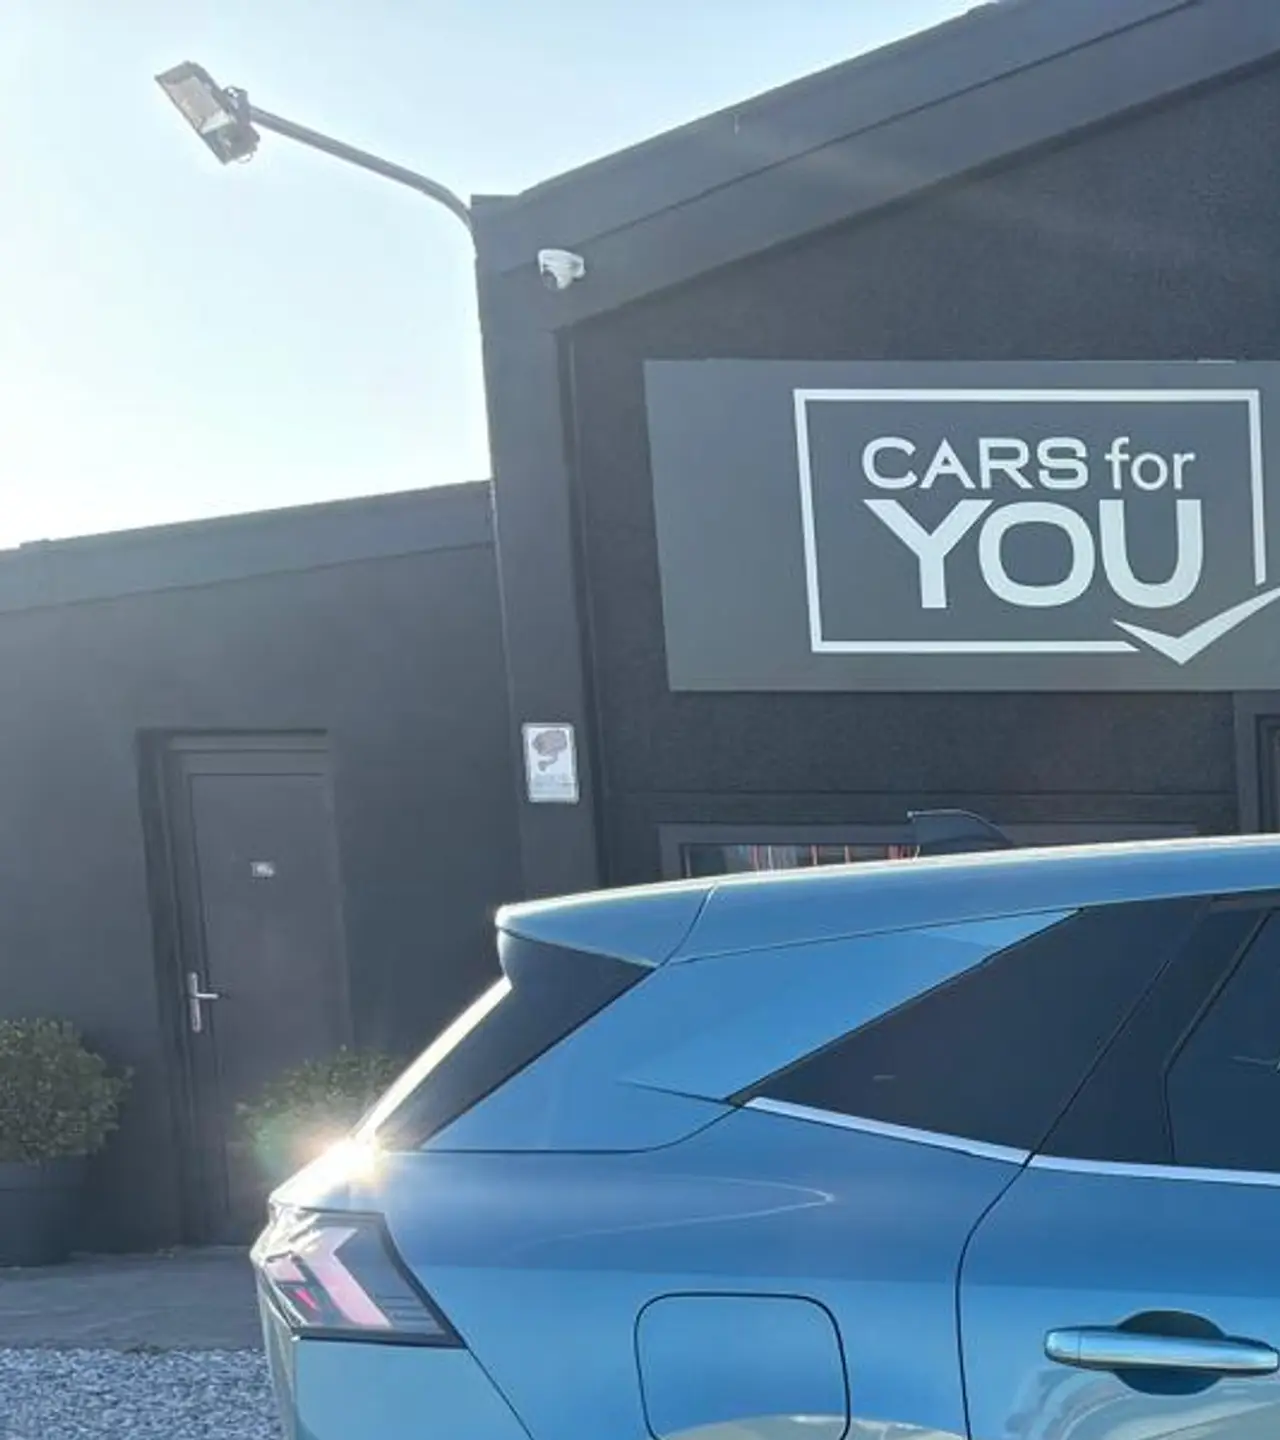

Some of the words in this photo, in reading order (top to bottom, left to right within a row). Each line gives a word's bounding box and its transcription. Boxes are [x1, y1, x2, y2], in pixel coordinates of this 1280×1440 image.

[863, 437, 1089, 490] CARS
[1104, 436, 1196, 491] for
[863, 498, 1203, 609] YOU
